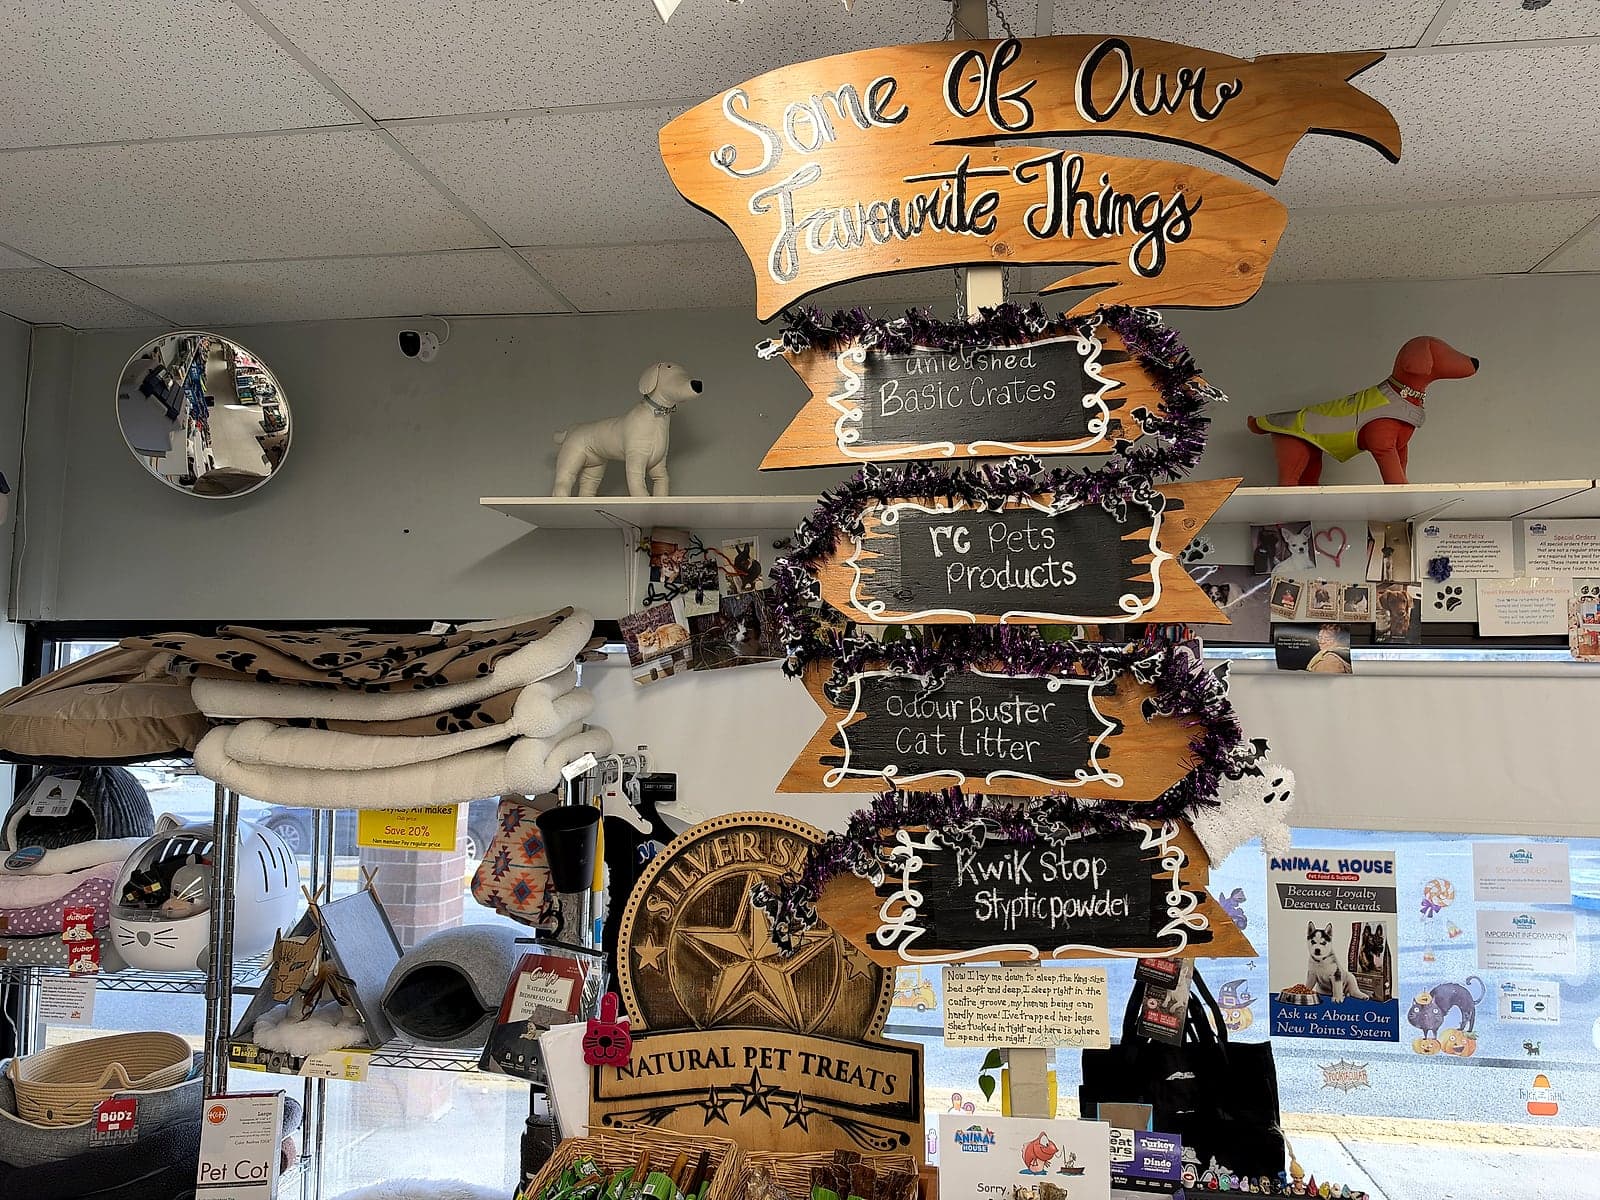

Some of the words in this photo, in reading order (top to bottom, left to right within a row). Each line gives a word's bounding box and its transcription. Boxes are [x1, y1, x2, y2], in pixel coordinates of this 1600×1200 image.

[709, 75, 908, 178] Some
[943, 36, 1037, 133] Of
[1074, 37, 1242, 124] Our
[748, 153, 1010, 283] Favourite
[1014, 150, 1201, 277] Things
[879, 379, 963, 416] Basic
[970, 376, 1056, 407] Crates
[886, 696, 964, 722] Odour
[969, 697, 1056, 724] Buster
[895, 725, 947, 755] Cat
[958, 725, 1041, 764] Litter
[425, 806, 452, 814] makes
[384, 826, 406, 836] Save
[408, 826, 430, 837] 20%
[1041, 850, 1107, 892] Stop
[1270, 857, 1330, 872] ANIMAL
[1338, 859, 1393, 874] HOUSE
[646, 832, 766, 922] SILVER
[1288, 885, 1332, 898] Because
[1336, 887, 1376, 900] Loyalty
[974, 890, 1047, 931] Styptic
[1049, 892, 1129, 929] powder
[1284, 898, 1330, 910] Deserves
[1335, 900, 1381, 911] Rewards
[1485, 930, 1520, 939] IMPORTANT
[530, 966, 560, 988] Comfy
[948, 970, 966, 980] Now
[968, 970, 975, 980] I
[976, 970, 990, 984] lay
[1004, 972, 1024, 982] down
[1026, 972, 1034, 982] to
[526, 985, 558, 994] WATERPROOF
[947, 982, 963, 992] bed
[966, 984, 986, 996] soft
[1031, 986, 1052, 996] sleep
[1053, 986, 1074, 996] right
[1074, 986, 1083, 995] in
[1086, 986, 1102, 996] the
[1010, 1000, 1022, 1010] my
[1023, 996, 1048, 1008] human
[1050, 998, 1074, 1010] being
[947, 1008, 974, 1020] hardly
[1019, 1010, 1056, 1023] trapped
[1058, 1012, 1072, 1022] her
[1277, 1008, 1300, 1019] Ask
[1304, 1012, 1318, 1020] us
[1322, 1010, 1360, 1022] About
[1364, 1011, 1391, 1024] Our
[966, 1020, 996, 1032] tucked
[998, 1024, 1005, 1032] in
[1005, 1022, 1026, 1034] tight
[1026, 1024, 1042, 1034] and
[1044, 1024, 1062, 1034] here
[1064, 1026, 1072, 1034] is
[1074, 1026, 1100, 1036] where
[1277, 1022, 1305, 1033] New
[1309, 1022, 1346, 1036] Points
[1350, 1025, 1392, 1038] System
[947, 1032, 956, 1040] I
[958, 1034, 984, 1044] spend
[986, 1032, 1002, 1042] the
[615, 1046, 736, 1081] NATURAL
[743, 1046, 792, 1072] PET
[798, 1051, 898, 1096] TREATS
[954, 1131, 996, 1145] ANIMAL
[1110, 1138, 1132, 1146] eat
[1140, 1138, 1175, 1152] Turkey
[1110, 1146, 1132, 1155] ars
[201, 1162, 228, 1181] Pet
[234, 1160, 269, 1180] Cot
[976, 1182, 1010, 1196] Sorry,
